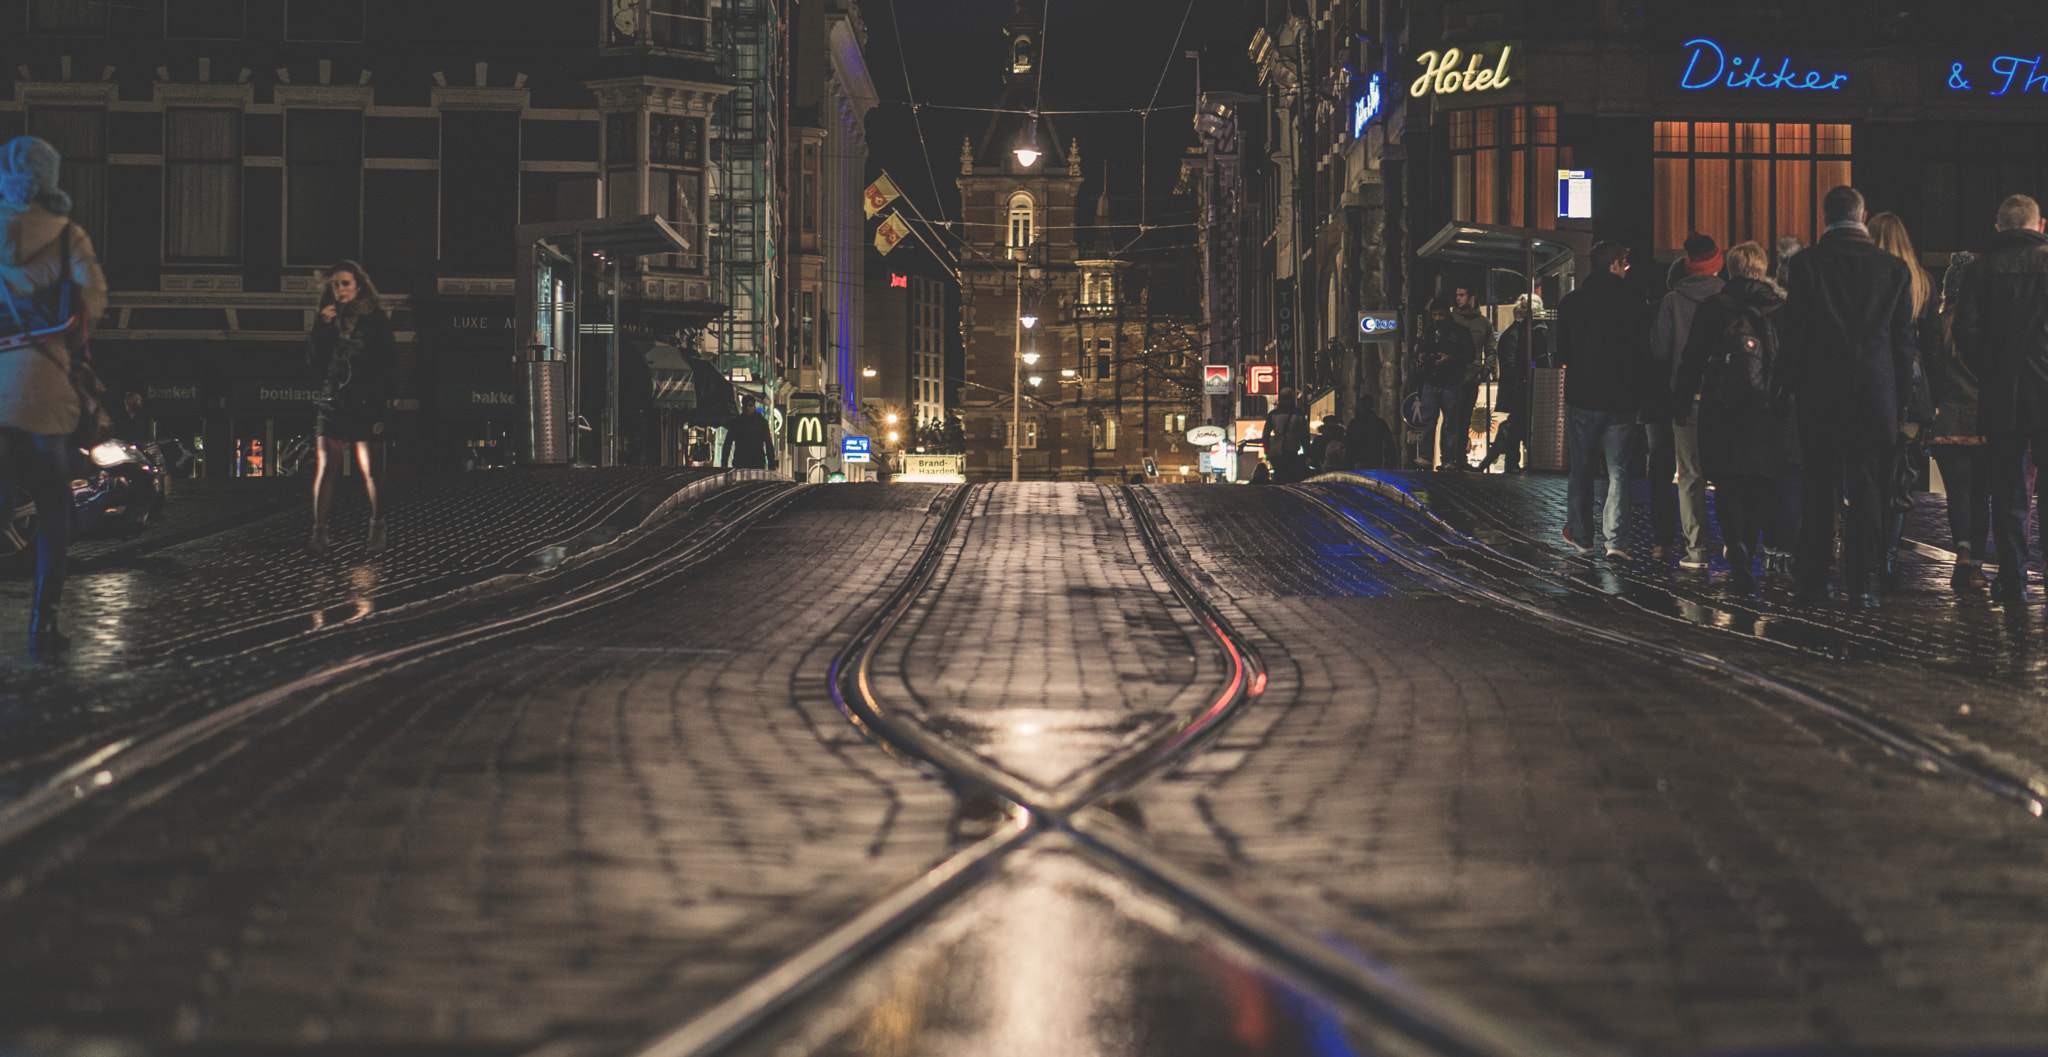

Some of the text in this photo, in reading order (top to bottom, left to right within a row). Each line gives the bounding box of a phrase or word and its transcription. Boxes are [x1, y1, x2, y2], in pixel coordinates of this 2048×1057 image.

[1409, 44, 1513, 98] Hotel
[1680, 37, 1848, 90] Dikker
[1947, 60, 1973, 90] &
[452, 316, 489, 329] LUXE
[918, 459, 948, 467] Brand-
